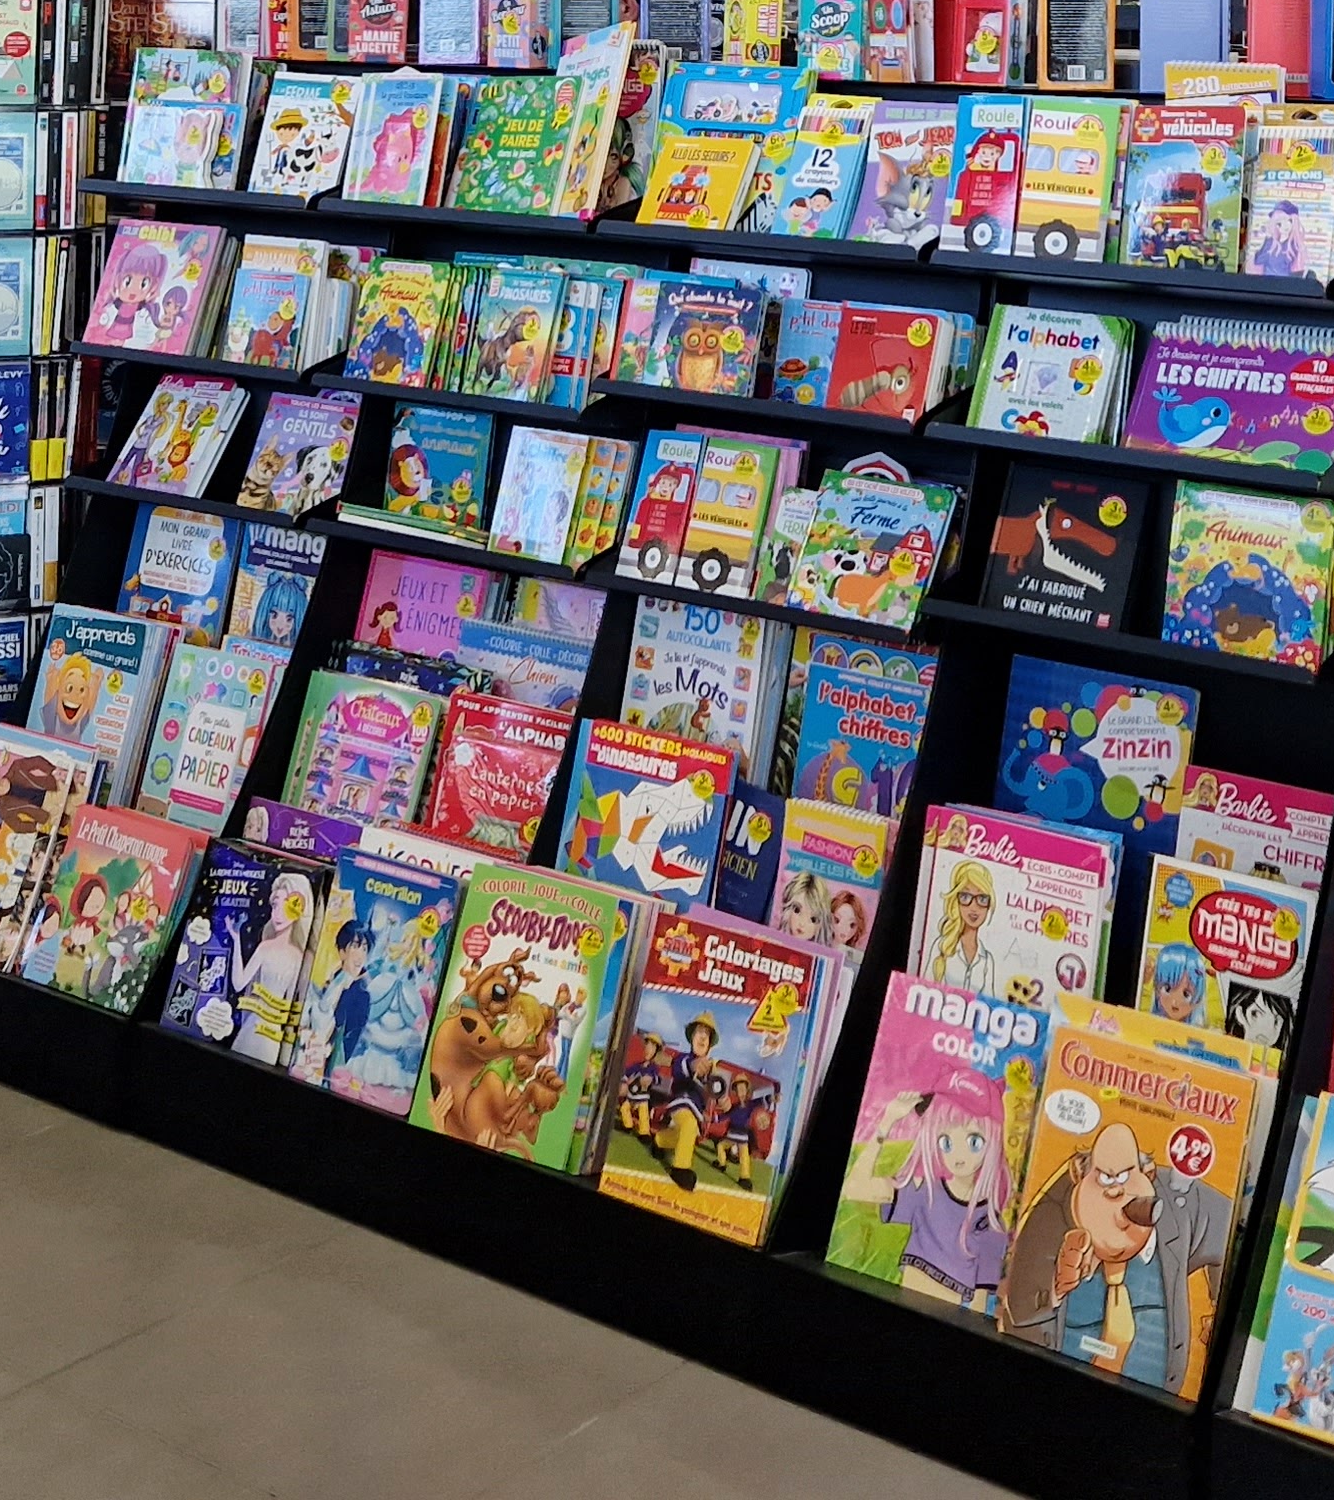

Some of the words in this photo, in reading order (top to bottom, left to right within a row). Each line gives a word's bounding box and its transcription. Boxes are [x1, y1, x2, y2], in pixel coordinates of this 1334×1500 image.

[360, 2, 397, 18] Astuce
[757, 4, 769, 33] INFO
[810, 11, 849, 30] Scoop
[357, 42, 399, 53] LUCETTE
[363, 31, 400, 42] MAMIE
[1182, 76, 1220, 95] 280
[1221, 81, 1272, 91] AUTOCOLLANTS
[506, 119, 527, 133] JEU
[528, 118, 544, 132] DE
[977, 109, 1019, 125] Roule,
[1162, 118, 1234, 136] véhicules
[500, 134, 541, 147] PAIRES
[875, 130, 903, 149] TOM
[812, 148, 833, 167] 12
[806, 177, 838, 186] couleurs
[1032, 181, 1045, 192] LES
[1046, 183, 1087, 195] VÉHICULES
[1278, 172, 1323, 180] CRAYONS
[1026, 312, 1038, 322] Je
[1039, 313, 1082, 326] découvre
[1007, 322, 1100, 350] l'alphabet
[1311, 359, 1328, 373] 10
[1156, 363, 1193, 384] LES
[1195, 366, 1286, 395] CHIFFRES
[283, 417, 337, 439] GENTILS
[850, 505, 901, 530] Ferme
[159, 522, 179, 534] MON
[182, 525, 210, 541] GRAND
[171, 538, 193, 549] LIVRE
[1205, 521, 1288, 550] Animaux
[145, 548, 213, 576] D'EXERCICES
[391, 575, 429, 600] JEUX
[431, 582, 449, 605] ET
[1018, 575, 1039, 591] J'AI
[1042, 579, 1086, 600] FABRIQUÉ
[683, 606, 719, 634] 150
[1003, 596, 1017, 609] UN
[1020, 599, 1045, 615] CHIEN
[1048, 601, 1093, 624] MÉCHANT
[66, 620, 136, 647] J'apprends
[666, 630, 731, 652] AUTOCOLLANTS
[489, 636, 522, 652] COLORIE
[529, 643, 551, 657] COLLE
[509, 657, 560, 686] Chiens
[653, 679, 673, 695] les
[675, 667, 729, 710] Mots
[818, 682, 916, 721] l'alphabet
[350, 700, 402, 729] Châteaux
[188, 726, 236, 753] CADEAUX
[624, 732, 684, 756] STICKERS
[838, 717, 911, 747] chiffres
[1101, 735, 1173, 762] Zinzin
[179, 755, 229, 789] PAPIER
[470, 762, 544, 796] Lanternes
[469, 788, 485, 802] en
[488, 790, 538, 812] papier
[1214, 781, 1278, 825] Barbie
[805, 833, 855, 860] FASHION
[962, 822, 1022, 867] Barbie
[218, 880, 248, 896] JEUX
[482, 880, 530, 895] COLORIE,
[532, 885, 559, 902] JOUE
[570, 895, 602, 920] COLLE
[1034, 879, 1083, 900] APPRENDS
[703, 935, 805, 983] Coloriages
[697, 967, 745, 993] Jeux
[904, 983, 1038, 1046] manga
[932, 1031, 997, 1068] COLOR
[1059, 1039, 1240, 1124] Commerciaux
[1188, 1157, 1203, 1172] €
